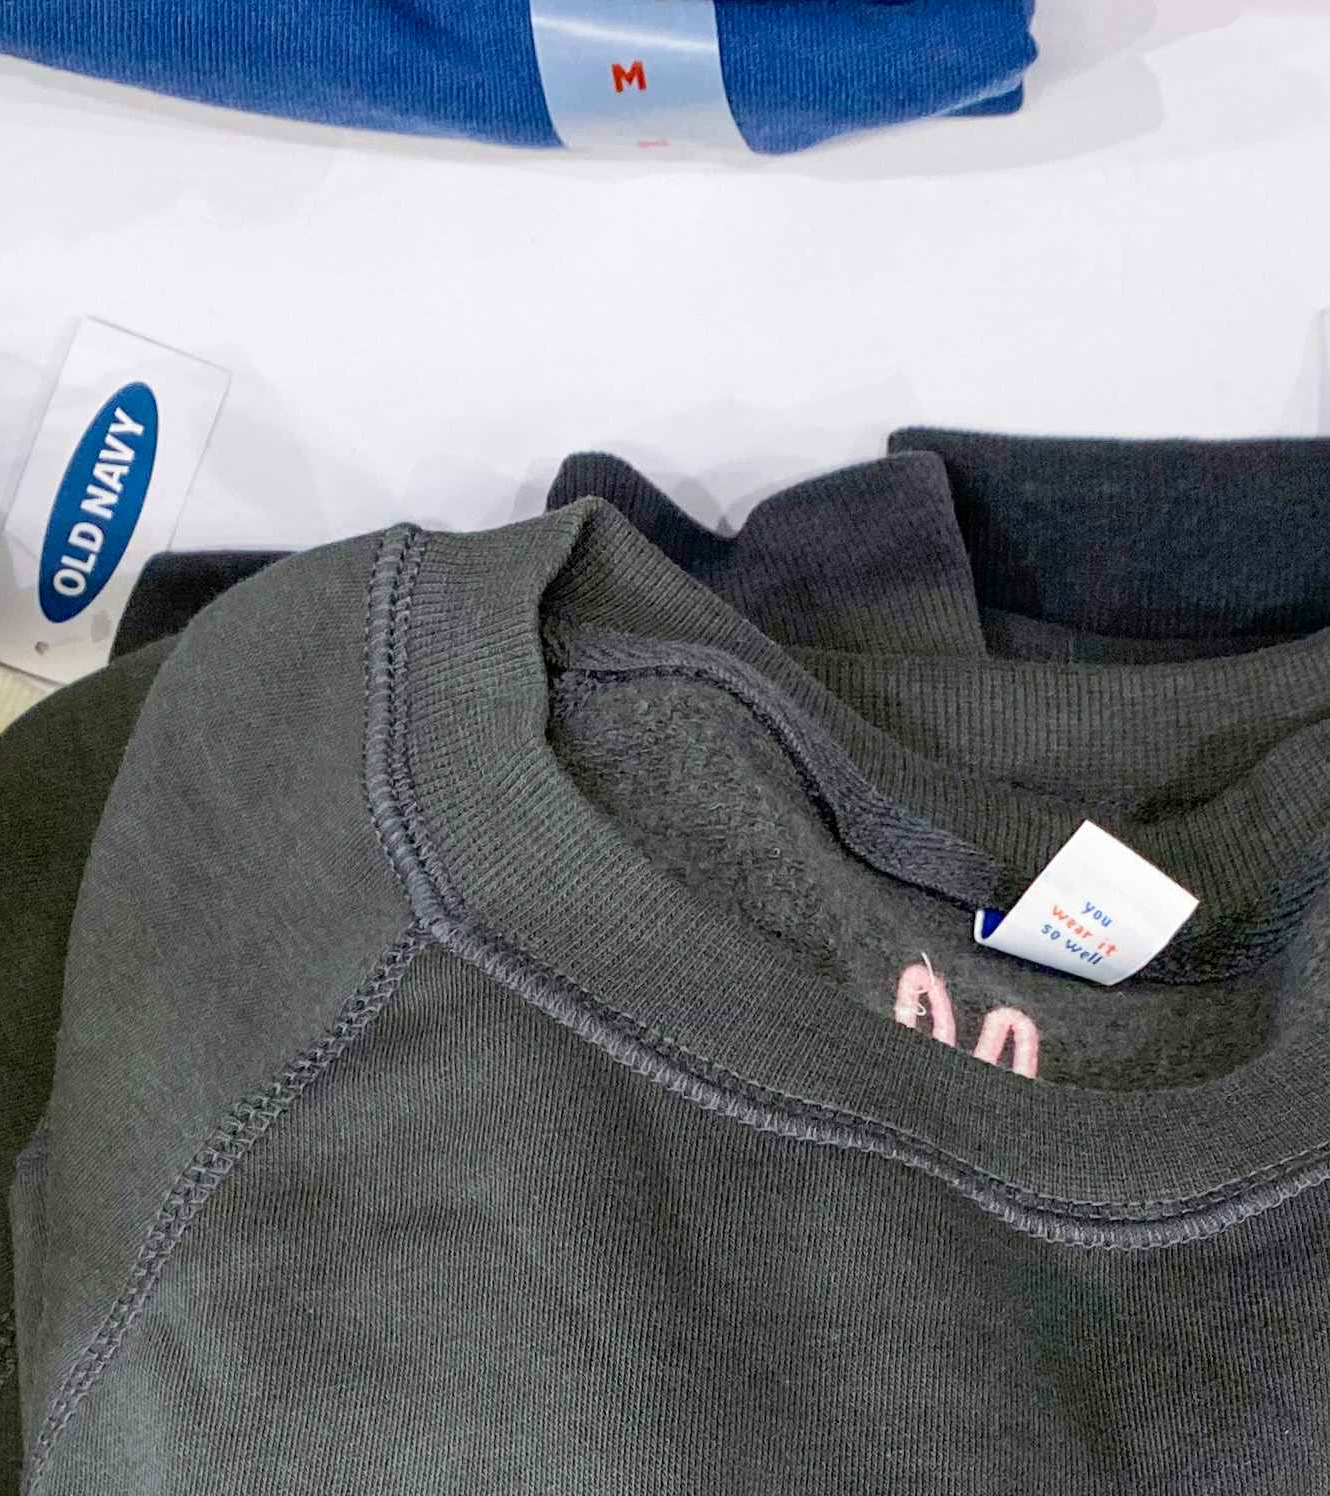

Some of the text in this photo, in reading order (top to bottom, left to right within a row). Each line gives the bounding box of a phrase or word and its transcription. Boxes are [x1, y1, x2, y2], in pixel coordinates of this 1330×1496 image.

[611, 60, 647, 93] M
[53, 406, 145, 597] OLD NAVY
[1053, 905, 1118, 957] wear it
[1081, 901, 1113, 927] you
[1041, 924, 1103, 965] so well
